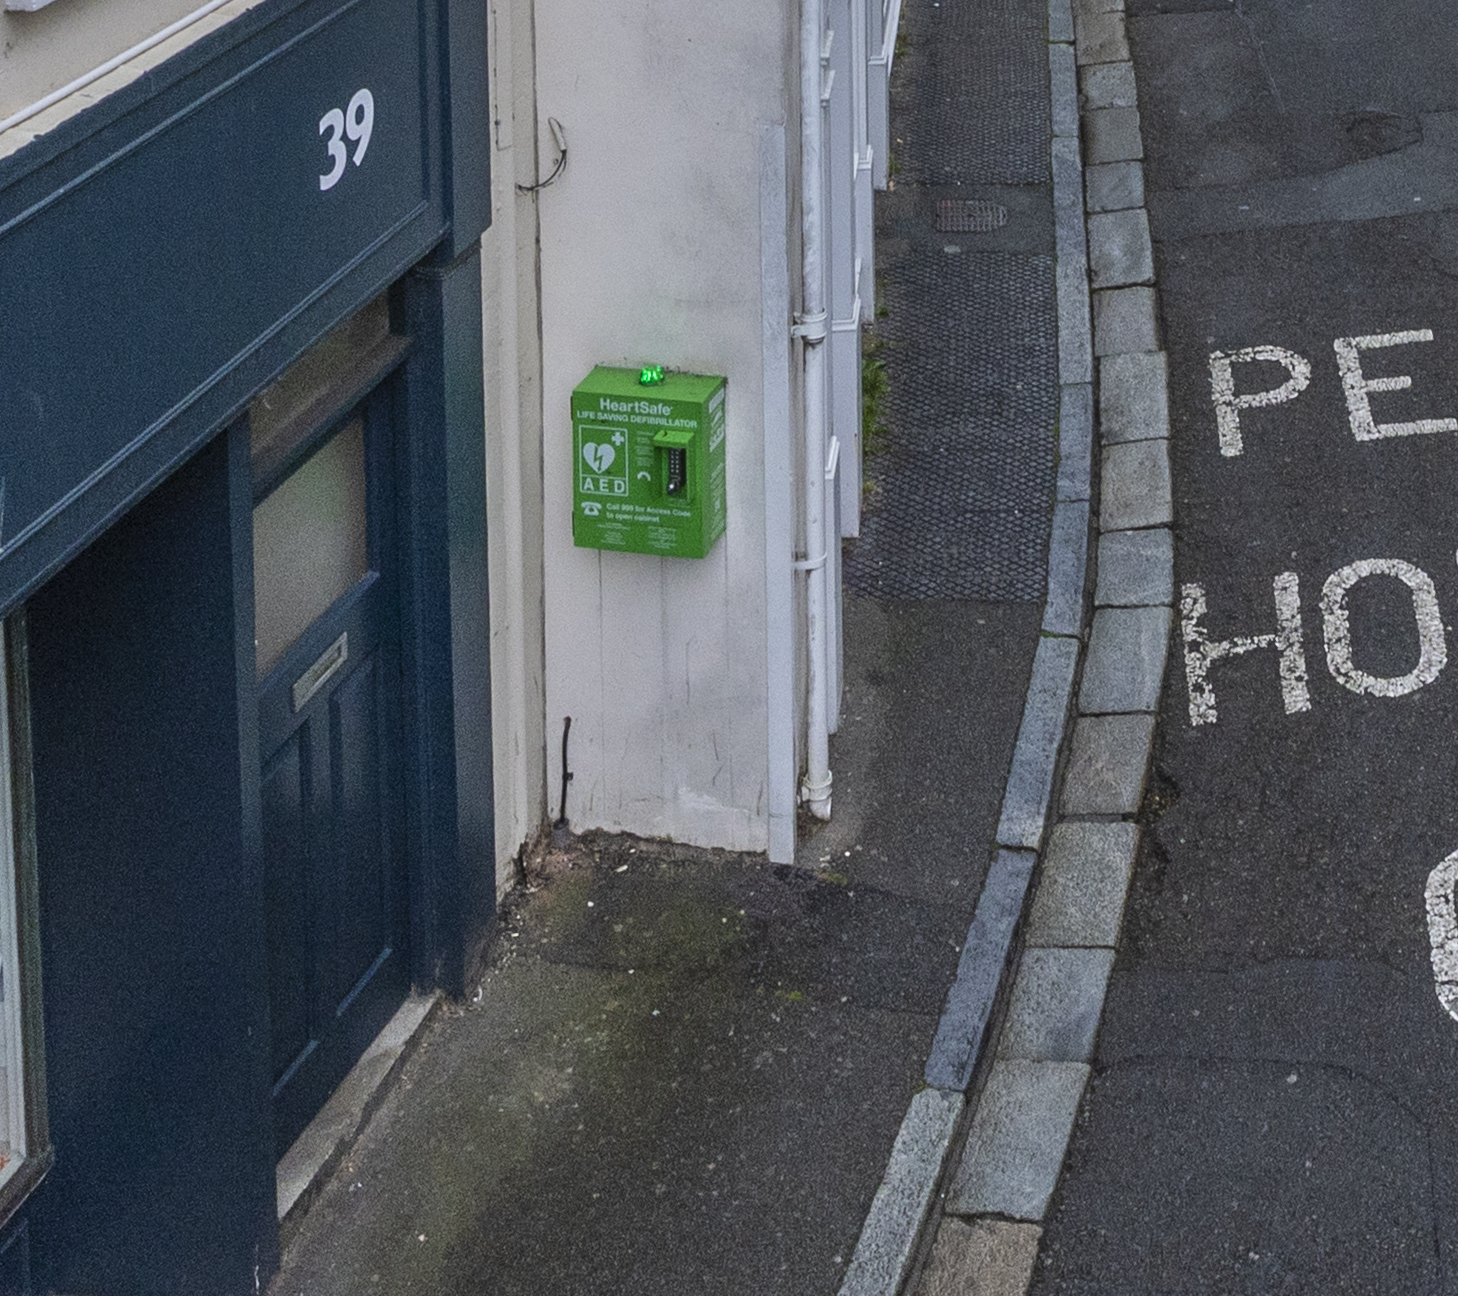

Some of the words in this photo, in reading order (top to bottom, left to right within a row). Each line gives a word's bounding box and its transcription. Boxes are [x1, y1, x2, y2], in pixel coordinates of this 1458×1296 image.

[319, 87, 375, 191] 39
[599, 397, 672, 416] HeartSafe
[576, 410, 596, 419] LIFE
[597, 412, 629, 422] SAVING
[630, 414, 698, 428] DEFIBRILLATOR
